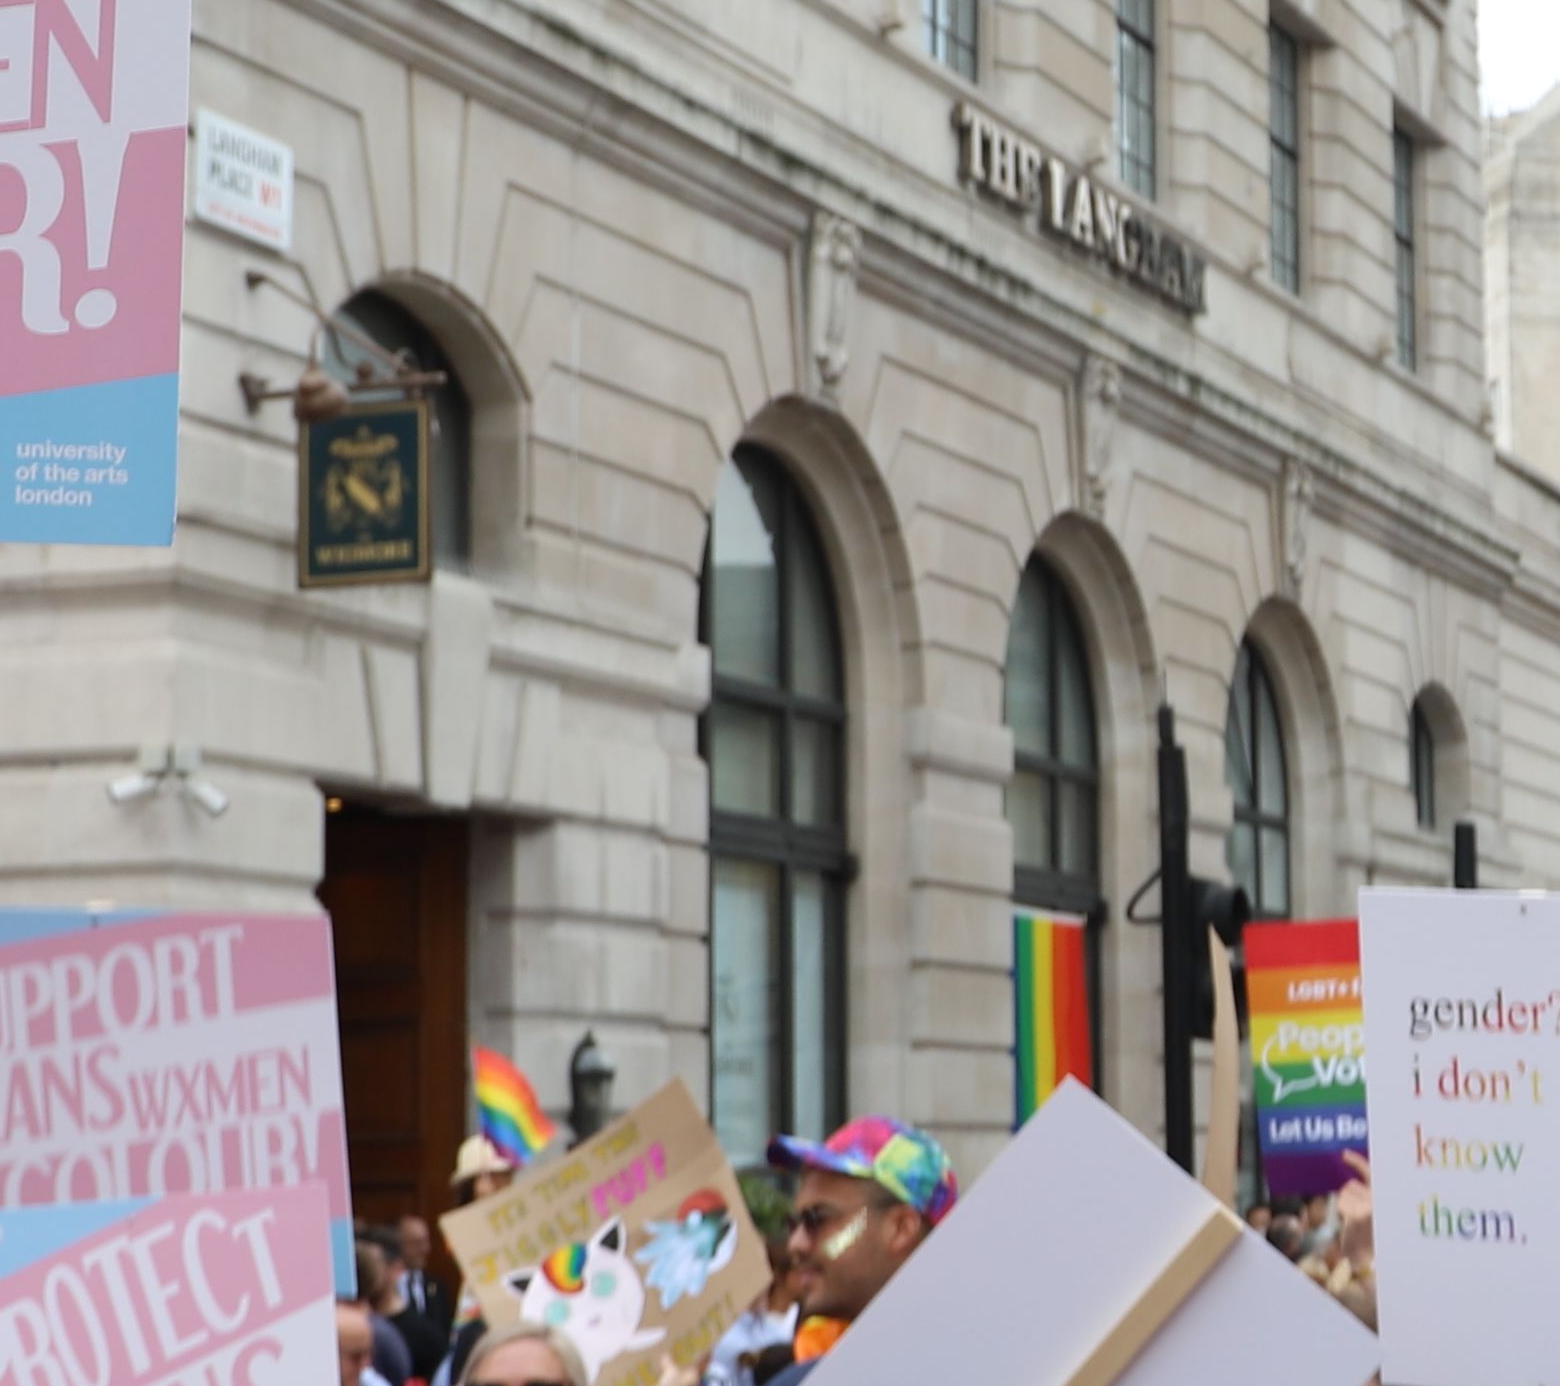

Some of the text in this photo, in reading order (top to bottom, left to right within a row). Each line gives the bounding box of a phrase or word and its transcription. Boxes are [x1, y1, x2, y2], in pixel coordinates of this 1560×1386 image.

[16, 439, 128, 465] university
[15, 462, 129, 486] of the arts
[15, 485, 93, 507] london
[1277, 1019, 1365, 1055] Peop
[128, 1042, 313, 1135] WXMEN
[1312, 1053, 1367, 1088] Vo
[1411, 1062, 1424, 1099] i
[1414, 1125, 1526, 1174] know
[1417, 1198, 1530, 1246] them.
